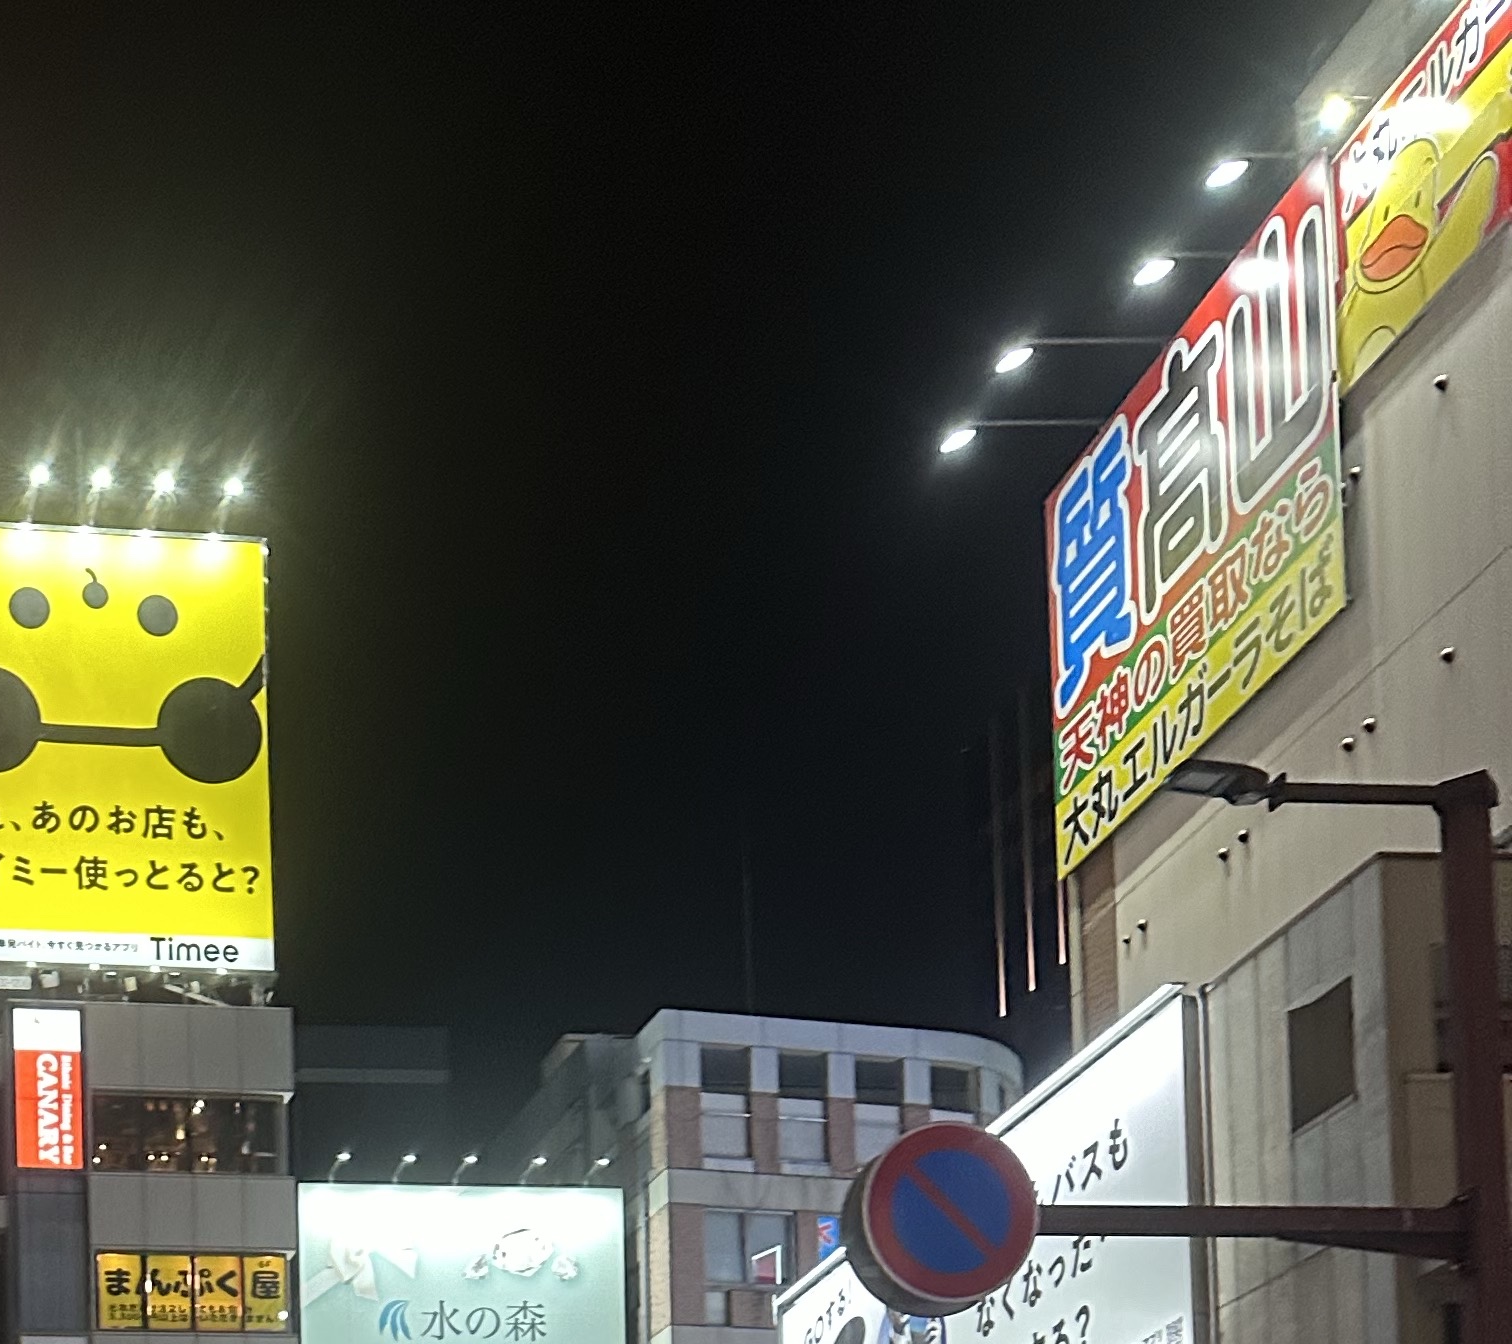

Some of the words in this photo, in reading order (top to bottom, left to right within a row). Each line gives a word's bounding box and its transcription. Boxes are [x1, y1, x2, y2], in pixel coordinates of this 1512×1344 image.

[1060, 456, 1332, 796] 天神の買取なら
[1063, 532, 1336, 868] 大丸エルガーラそば
[149, 936, 240, 963] Timee
[36, 1053, 60, 1166] CANARY
[420, 1300, 548, 1342] 水の森
